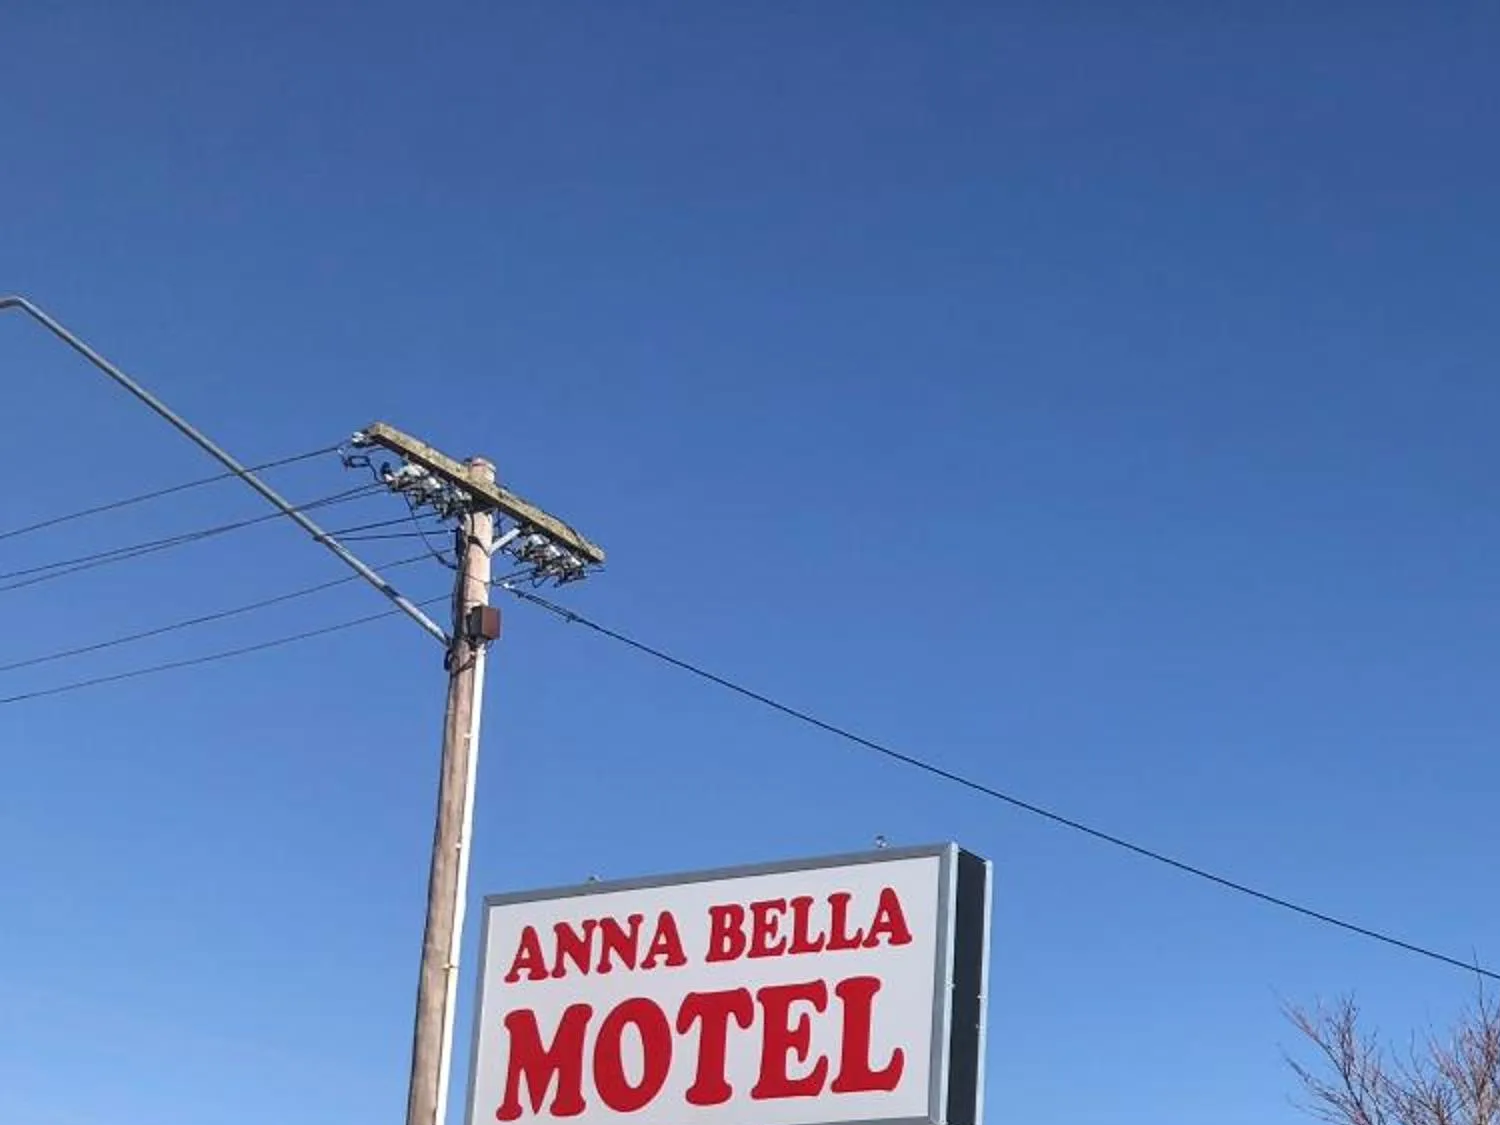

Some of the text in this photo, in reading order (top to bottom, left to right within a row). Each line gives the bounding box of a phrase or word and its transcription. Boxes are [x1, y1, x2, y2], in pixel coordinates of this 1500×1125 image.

[504, 888, 912, 983] ANNA BELLA
[496, 976, 905, 1122] MOTEL
